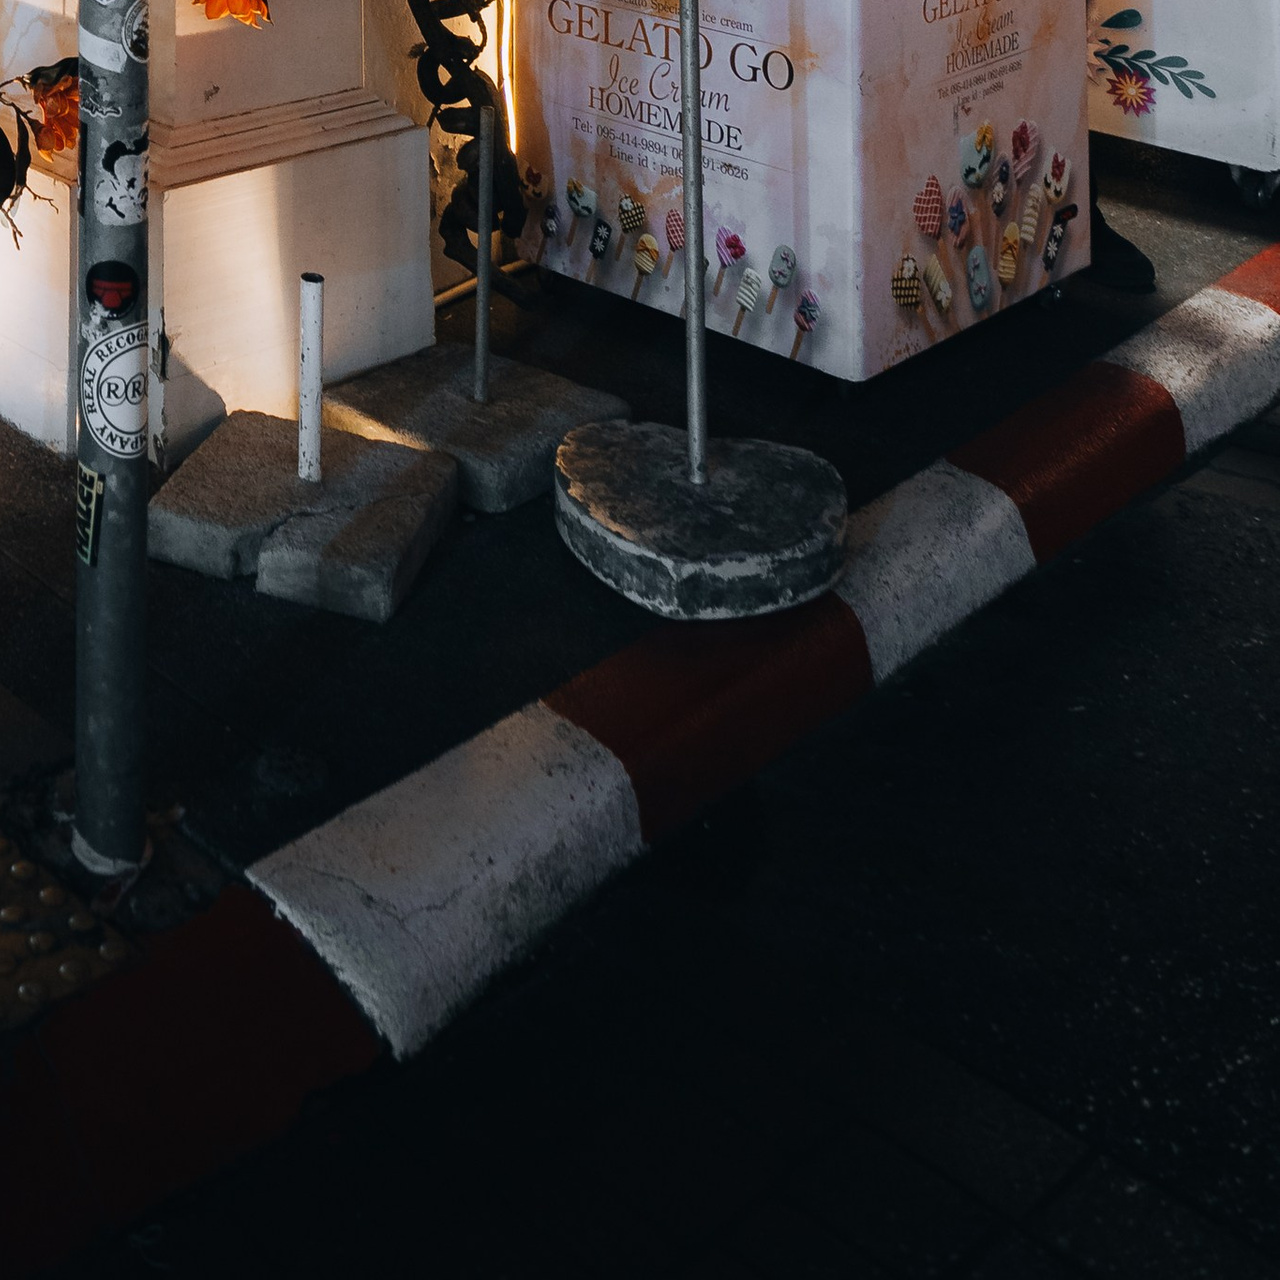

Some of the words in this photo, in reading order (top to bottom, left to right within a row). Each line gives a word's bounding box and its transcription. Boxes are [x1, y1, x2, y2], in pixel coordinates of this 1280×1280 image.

[701, 12, 717, 25] ice
[720, 18, 754, 33] cream
[976, 7, 1014, 40] Cream
[729, 42, 794, 91] GO
[946, 31, 1020, 74] HOMEMADE
[605, 53, 640, 96] Ice
[648, 61, 731, 112] Cram
[572, 116, 593, 134] Tel:
[588, 86, 743, 151] HOMEMDE
[609, 144, 634, 164] Line
[637, 154, 649, 169] id
[86, 368, 97, 415] REAL
